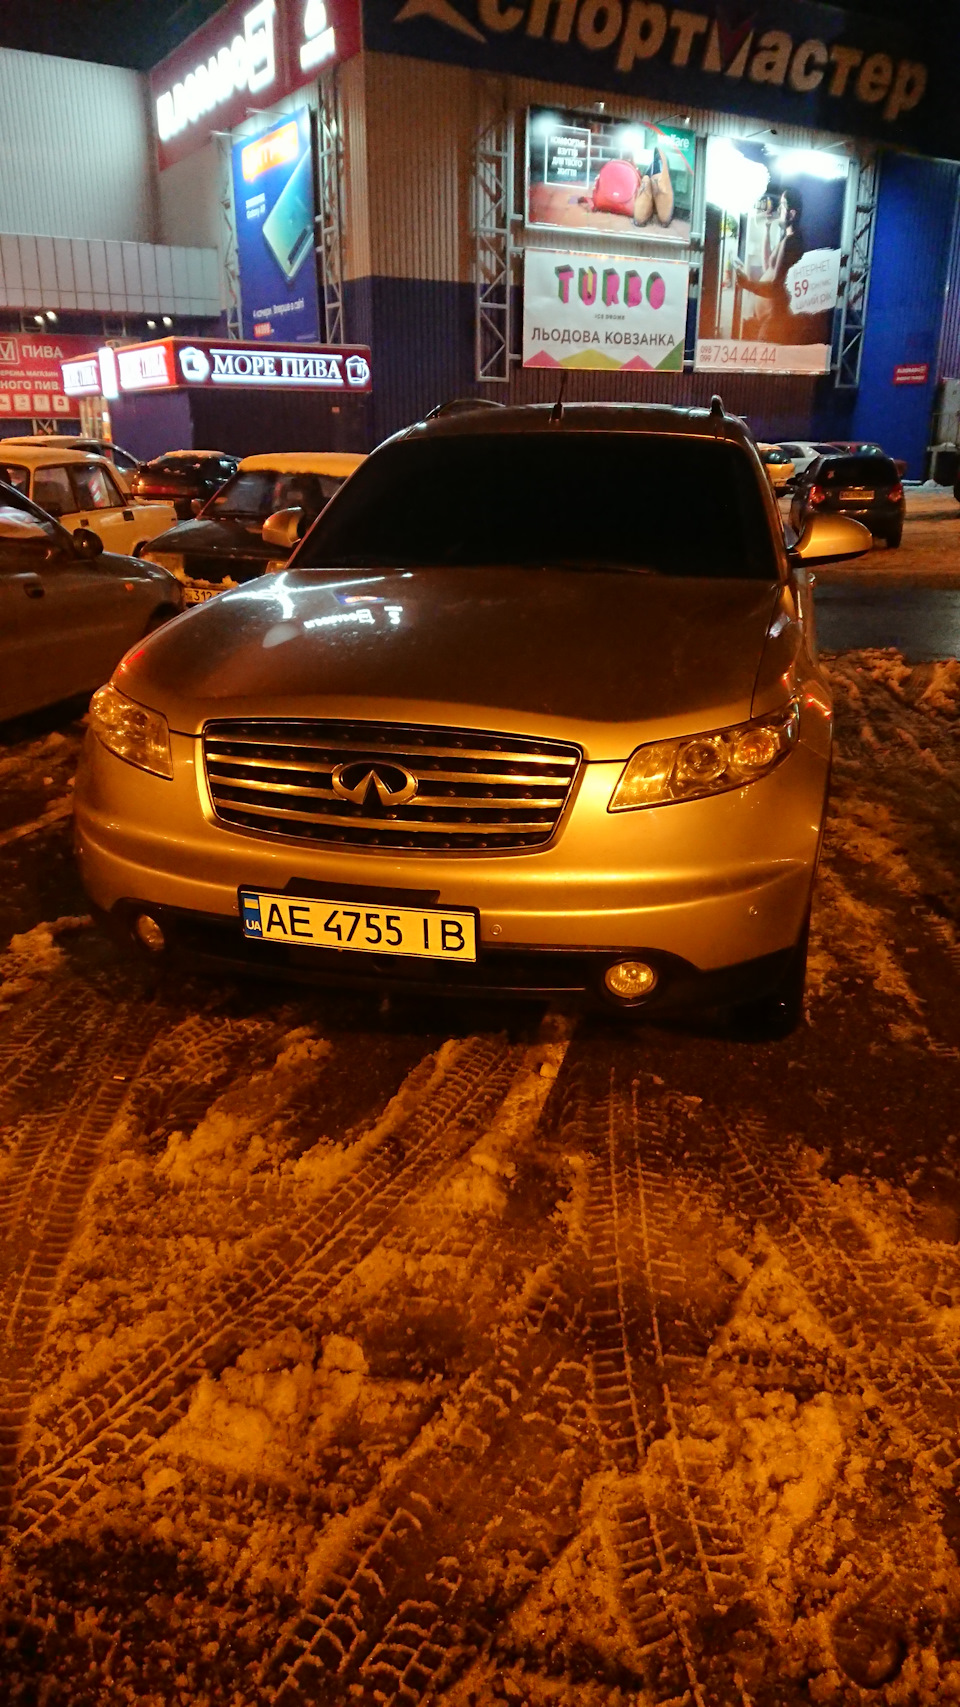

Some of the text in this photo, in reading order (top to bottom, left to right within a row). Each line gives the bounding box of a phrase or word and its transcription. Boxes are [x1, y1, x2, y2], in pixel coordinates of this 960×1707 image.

[555, 264, 665, 310] TURBO
[794, 279, 809, 298] 59
[531, 327, 675, 346] ЛЬОДОВА КОВЗАНКА
[22, 345, 63, 358] ПИВА
[714, 346, 737, 363] 734
[741, 347, 757, 363] 44
[760, 347, 776, 364] 44
[212, 355, 342, 379] МОРЕ ПИВА
[34, 381, 61, 390] ПИВ
[246, 919, 262, 932] UA
[266, 904, 465, 951] AE 4755 IB
